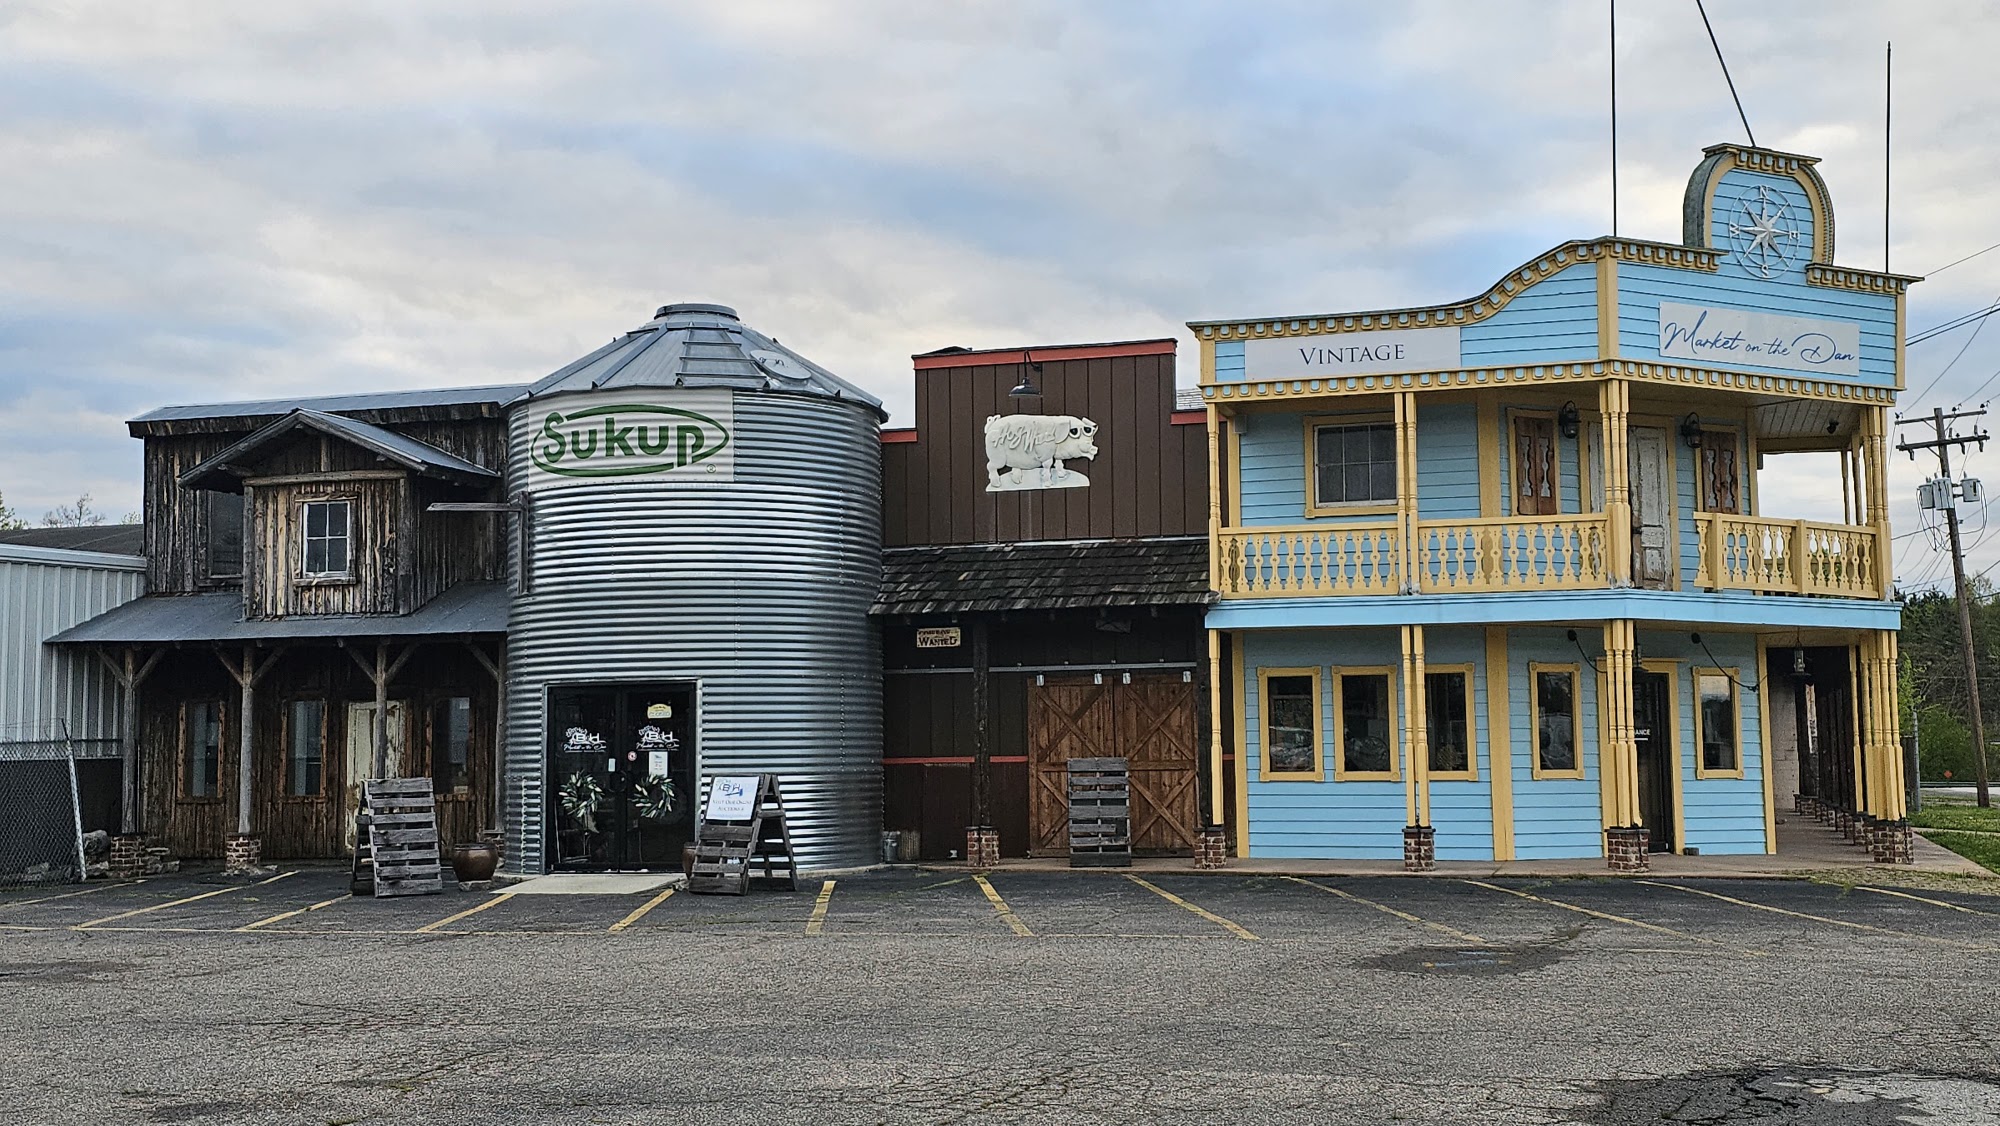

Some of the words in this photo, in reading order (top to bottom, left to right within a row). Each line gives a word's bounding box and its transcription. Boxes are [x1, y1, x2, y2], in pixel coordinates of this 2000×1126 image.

[1761, 264, 1769, 278] S
[1664, 310, 1745, 354] Market
[1745, 343, 1762, 353] on
[1763, 338, 1790, 356] the
[1791, 333, 1855, 364] Dan
[1299, 344, 1405, 365] VINTAGE
[918, 636, 957, 647] WANTED
